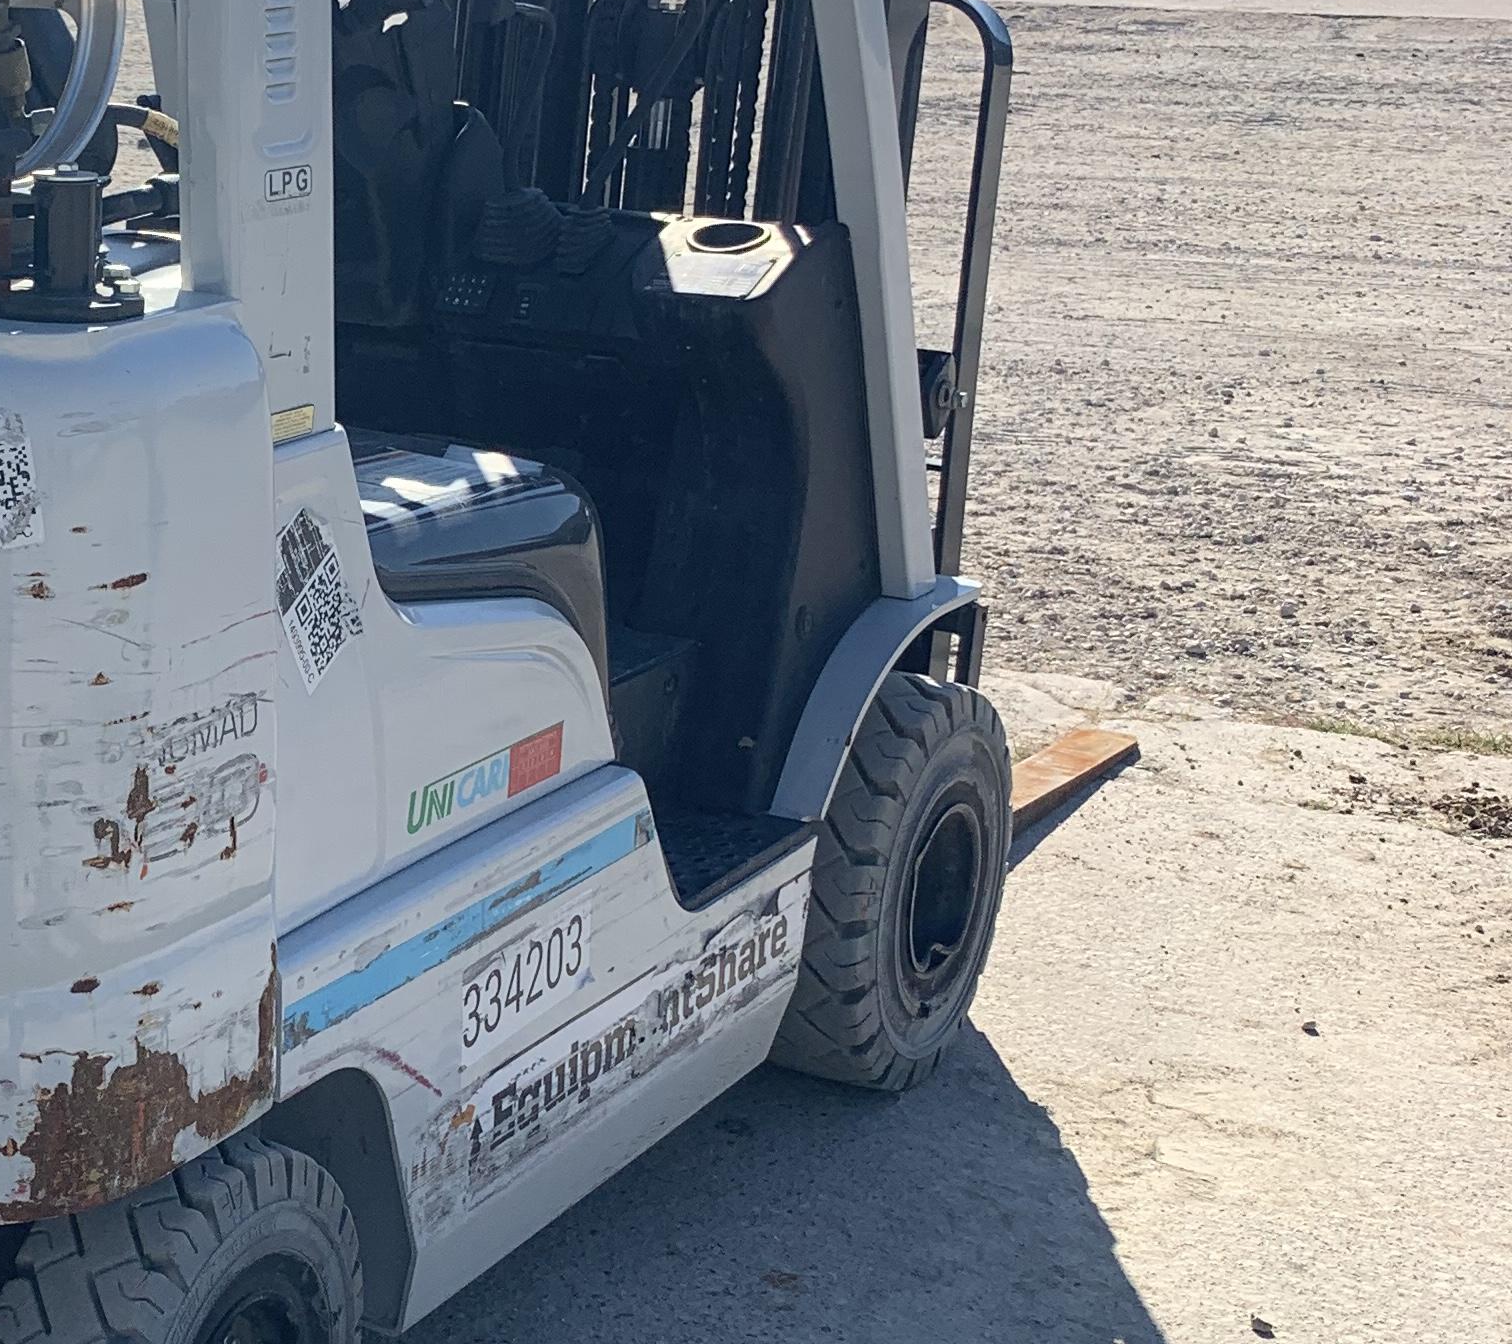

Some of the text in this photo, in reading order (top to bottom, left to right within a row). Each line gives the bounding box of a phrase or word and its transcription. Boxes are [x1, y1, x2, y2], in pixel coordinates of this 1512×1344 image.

[269, 168, 308, 197] LPG
[462, 914, 584, 1048] 334203
[491, 913, 788, 1150] EquipmntShare
